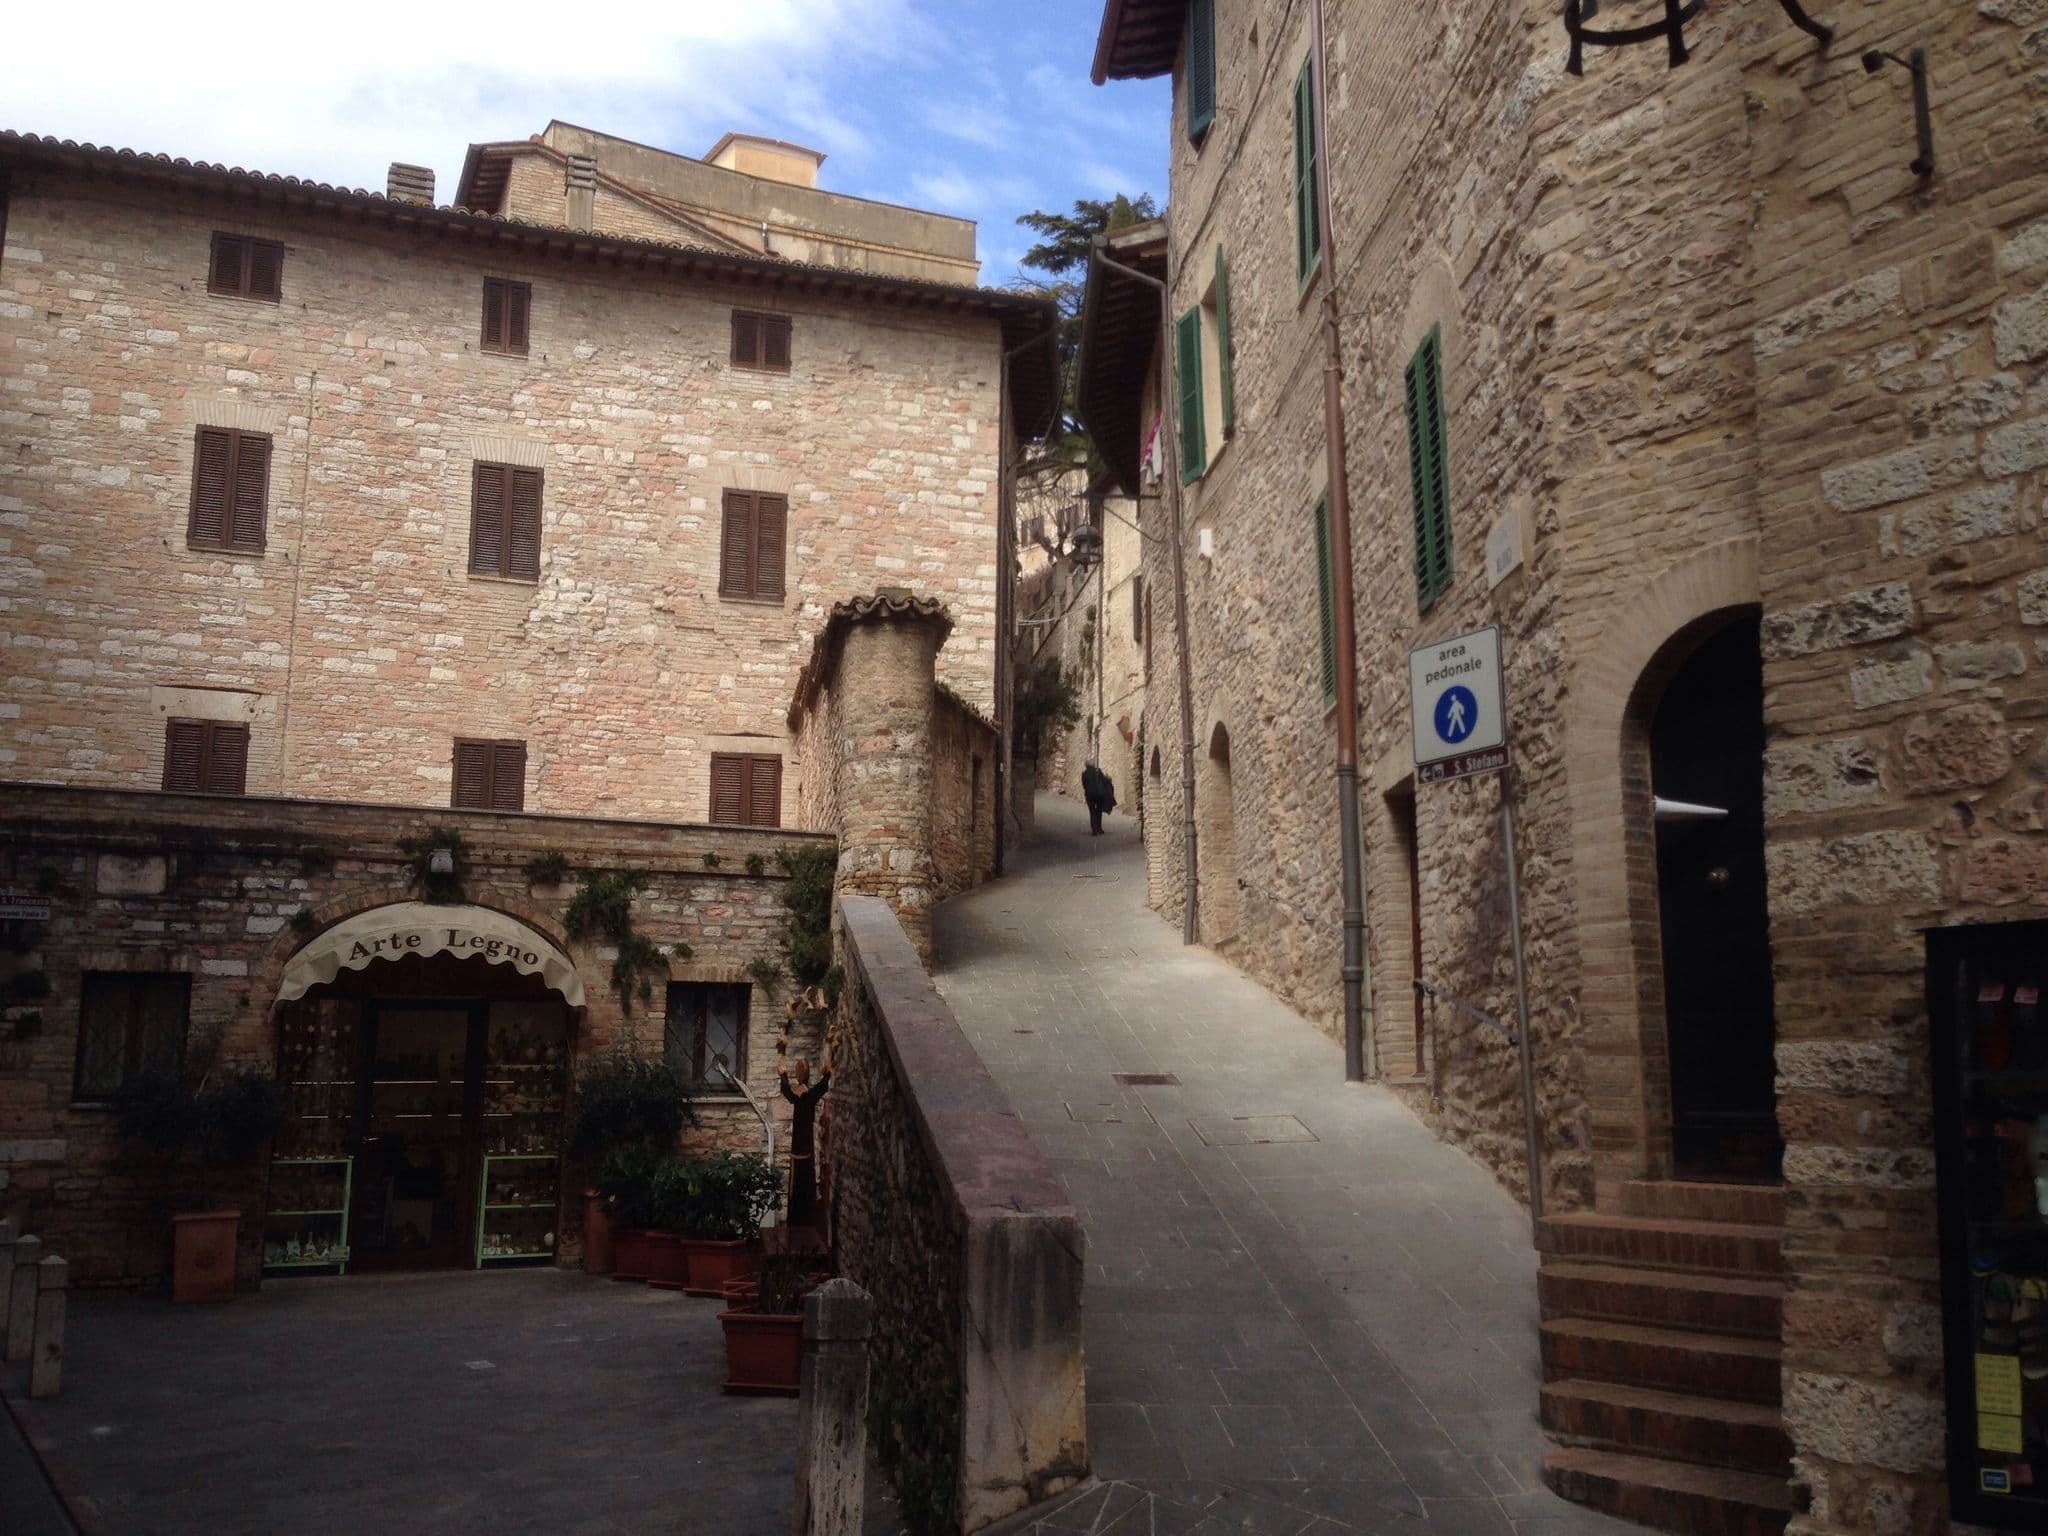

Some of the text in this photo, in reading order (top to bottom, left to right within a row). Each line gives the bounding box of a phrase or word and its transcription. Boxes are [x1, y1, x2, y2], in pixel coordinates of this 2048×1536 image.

[1439, 644, 1466, 662] area
[1425, 656, 1482, 685] pedonale
[1454, 753, 1504, 774] S. Stefano
[348, 929, 539, 966] Arte Legno
